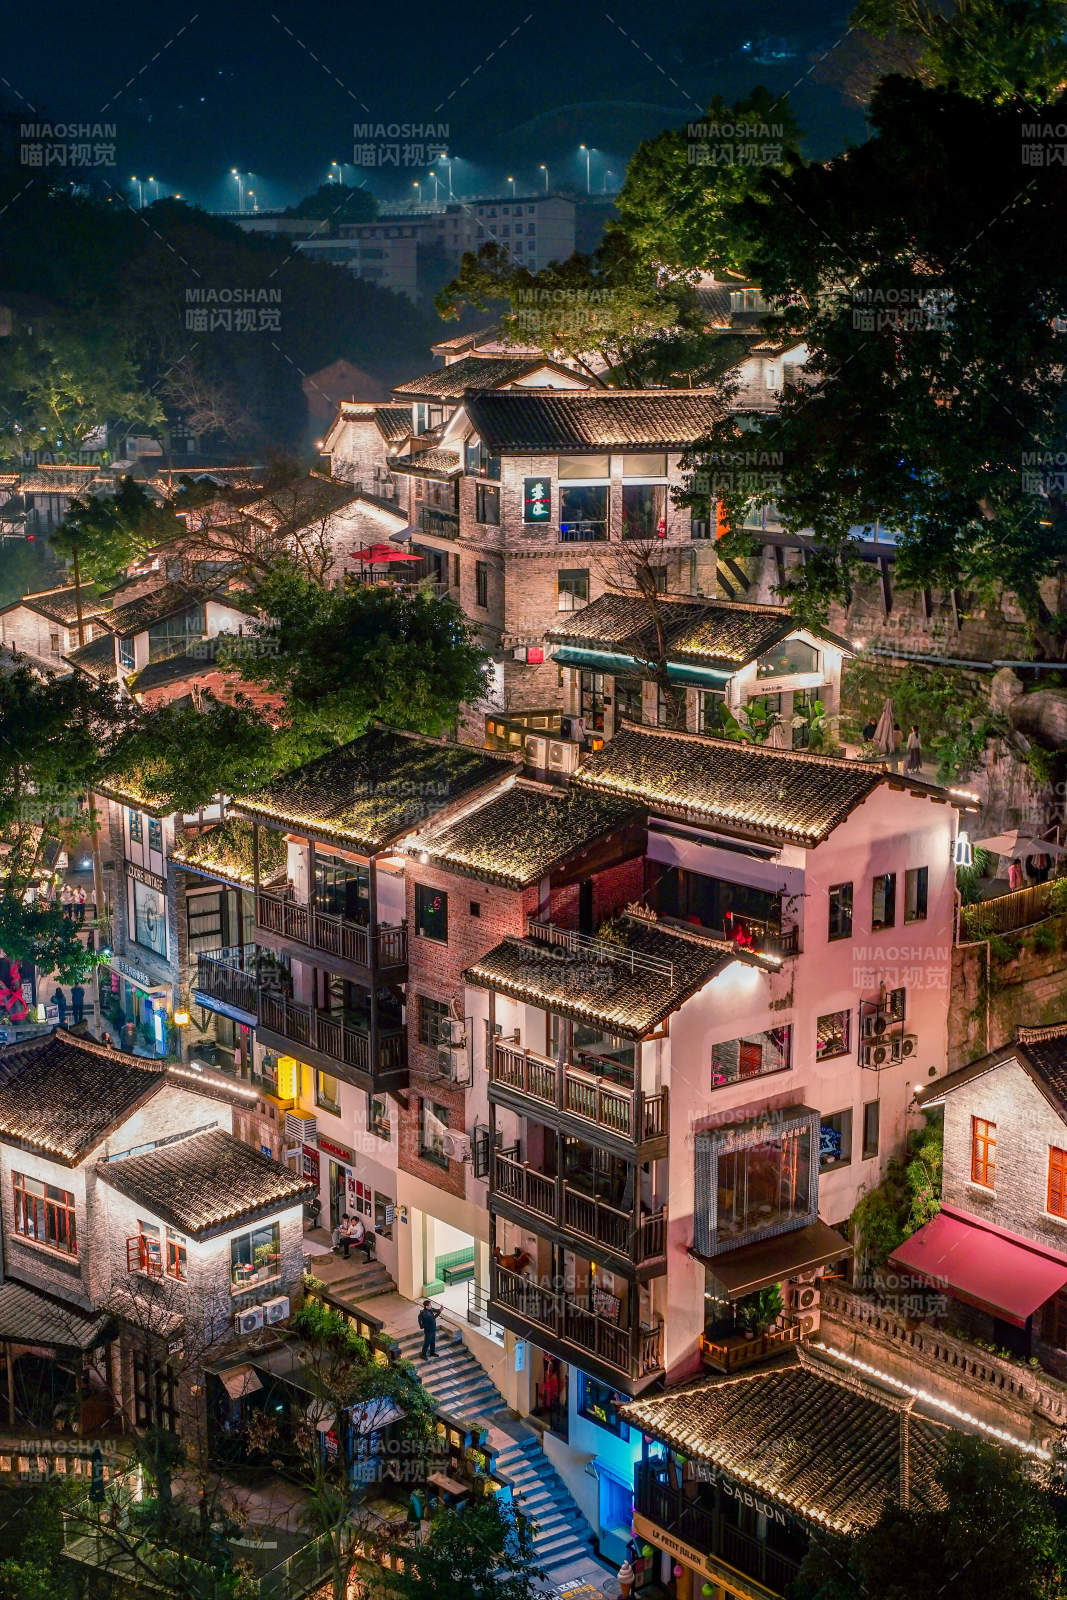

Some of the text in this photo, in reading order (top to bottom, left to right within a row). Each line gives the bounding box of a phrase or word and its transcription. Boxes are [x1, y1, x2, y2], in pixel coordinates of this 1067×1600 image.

[722, 1479, 786, 1527] SABLON
[661, 1535, 679, 1550] PETIT
[679, 1546, 702, 1565] JULIEN
